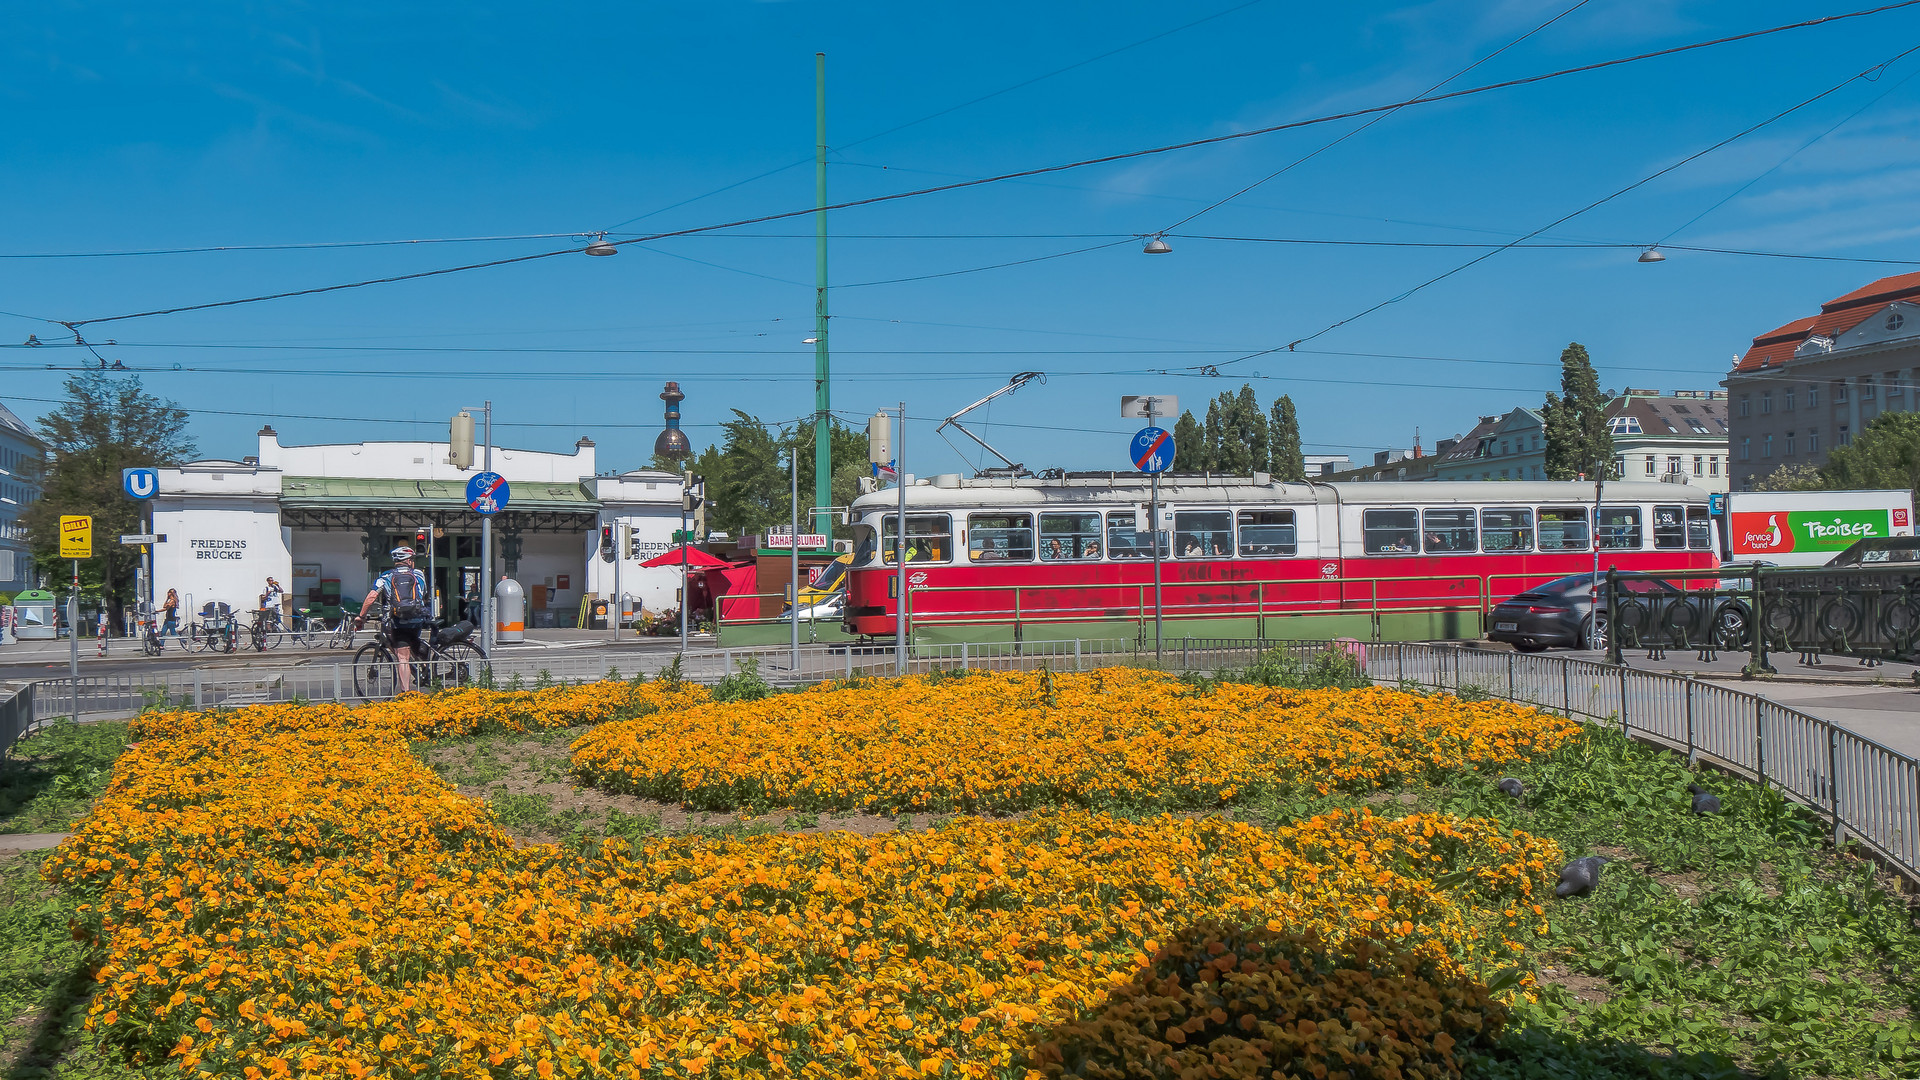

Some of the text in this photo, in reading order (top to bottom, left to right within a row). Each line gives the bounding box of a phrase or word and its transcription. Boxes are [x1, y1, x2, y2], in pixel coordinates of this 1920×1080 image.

[130, 474, 153, 496] U
[1662, 513, 1673, 522] 33
[64, 520, 88, 531] BILLA
[190, 539, 247, 549] FRIEDENS
[797, 535, 824, 545] BLUMEN
[1751, 541, 1768, 549] bund
[632, 542, 675, 550] RIEDENS
[196, 549, 243, 560] BRÜCKE
